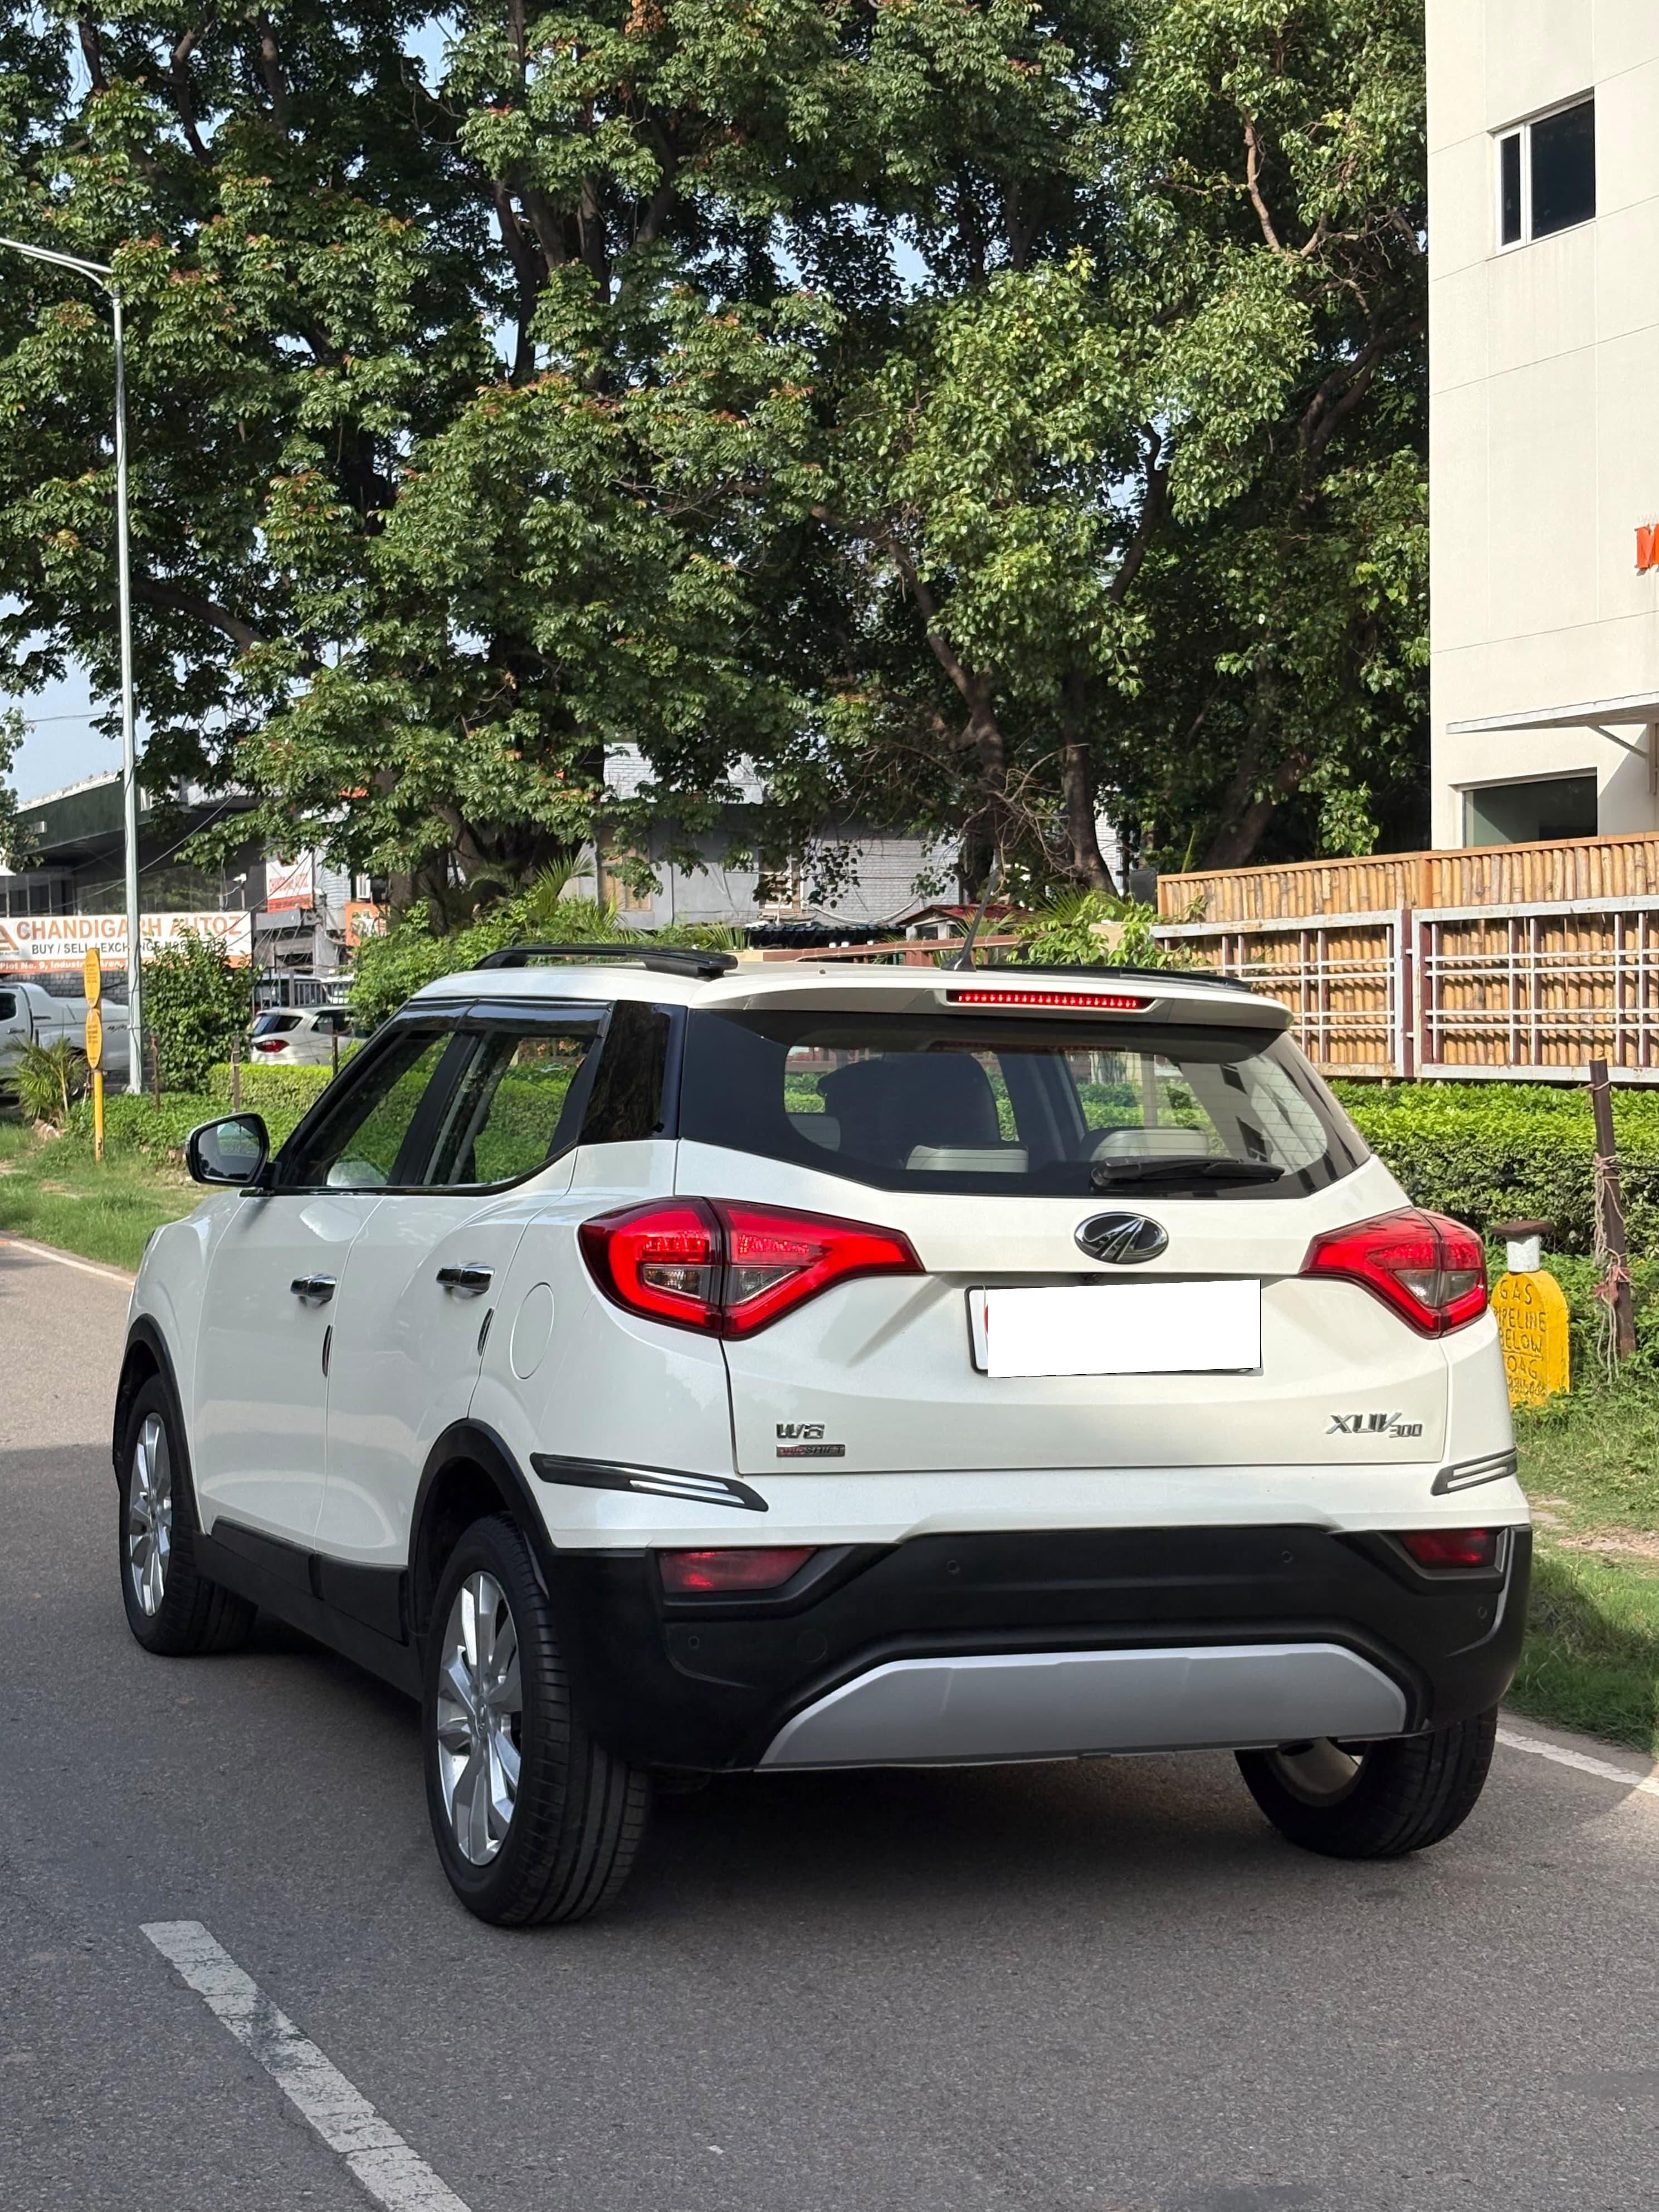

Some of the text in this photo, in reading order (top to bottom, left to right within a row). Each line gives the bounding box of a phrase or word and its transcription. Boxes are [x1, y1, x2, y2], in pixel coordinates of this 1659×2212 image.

[32, 944, 54, 955] BUY
[64, 943, 88, 954] SELL
[101, 939, 160, 953] EXCHGE
[0, 961, 18, 970] Plot
[21, 961, 36, 970] No.
[1499, 1280, 1532, 1305] GAS
[776, 1423, 825, 1439] W6
